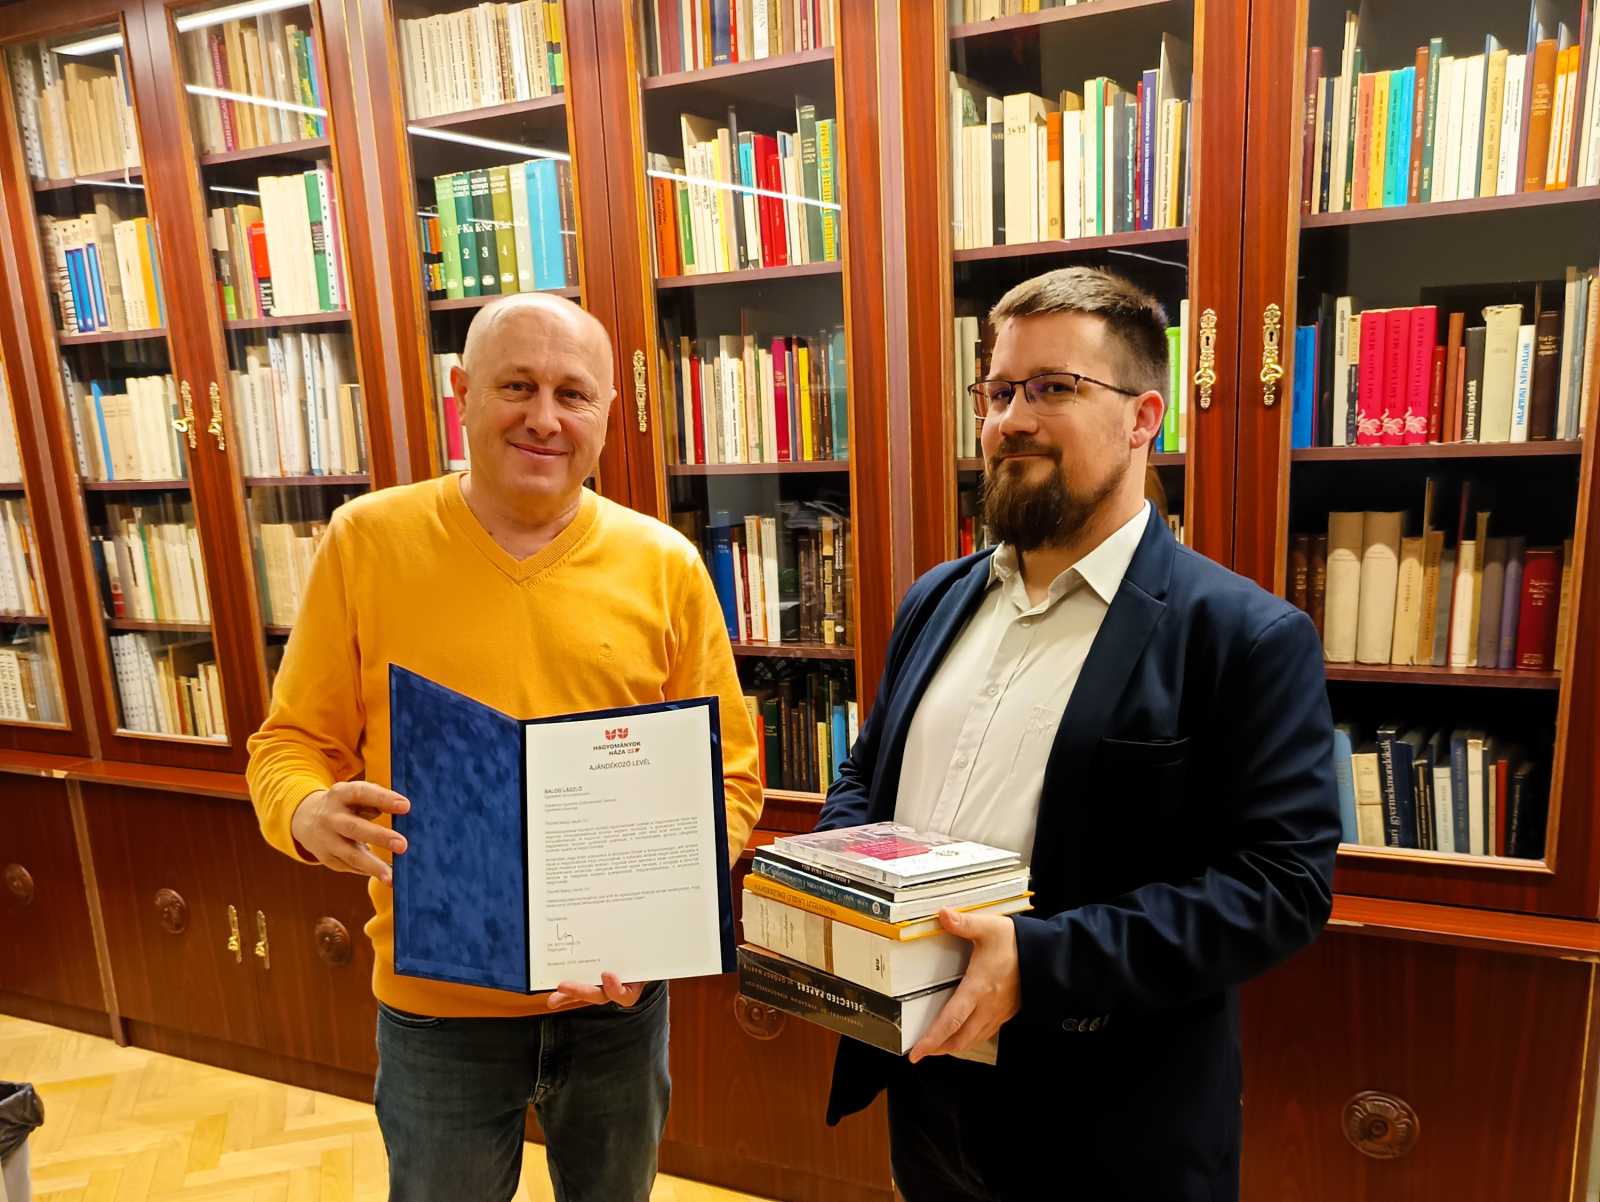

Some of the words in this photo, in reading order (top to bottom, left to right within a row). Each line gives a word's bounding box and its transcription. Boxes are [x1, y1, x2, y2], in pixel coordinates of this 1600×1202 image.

[463, 248, 471, 260] 2
[481, 246, 489, 258] 3
[592, 741, 641, 751] HAGYOMÁNYOK
[608, 748, 626, 756] HÁZA
[796, 982, 824, 999] PAPERS
[826, 992, 864, 1013] SELECTED
